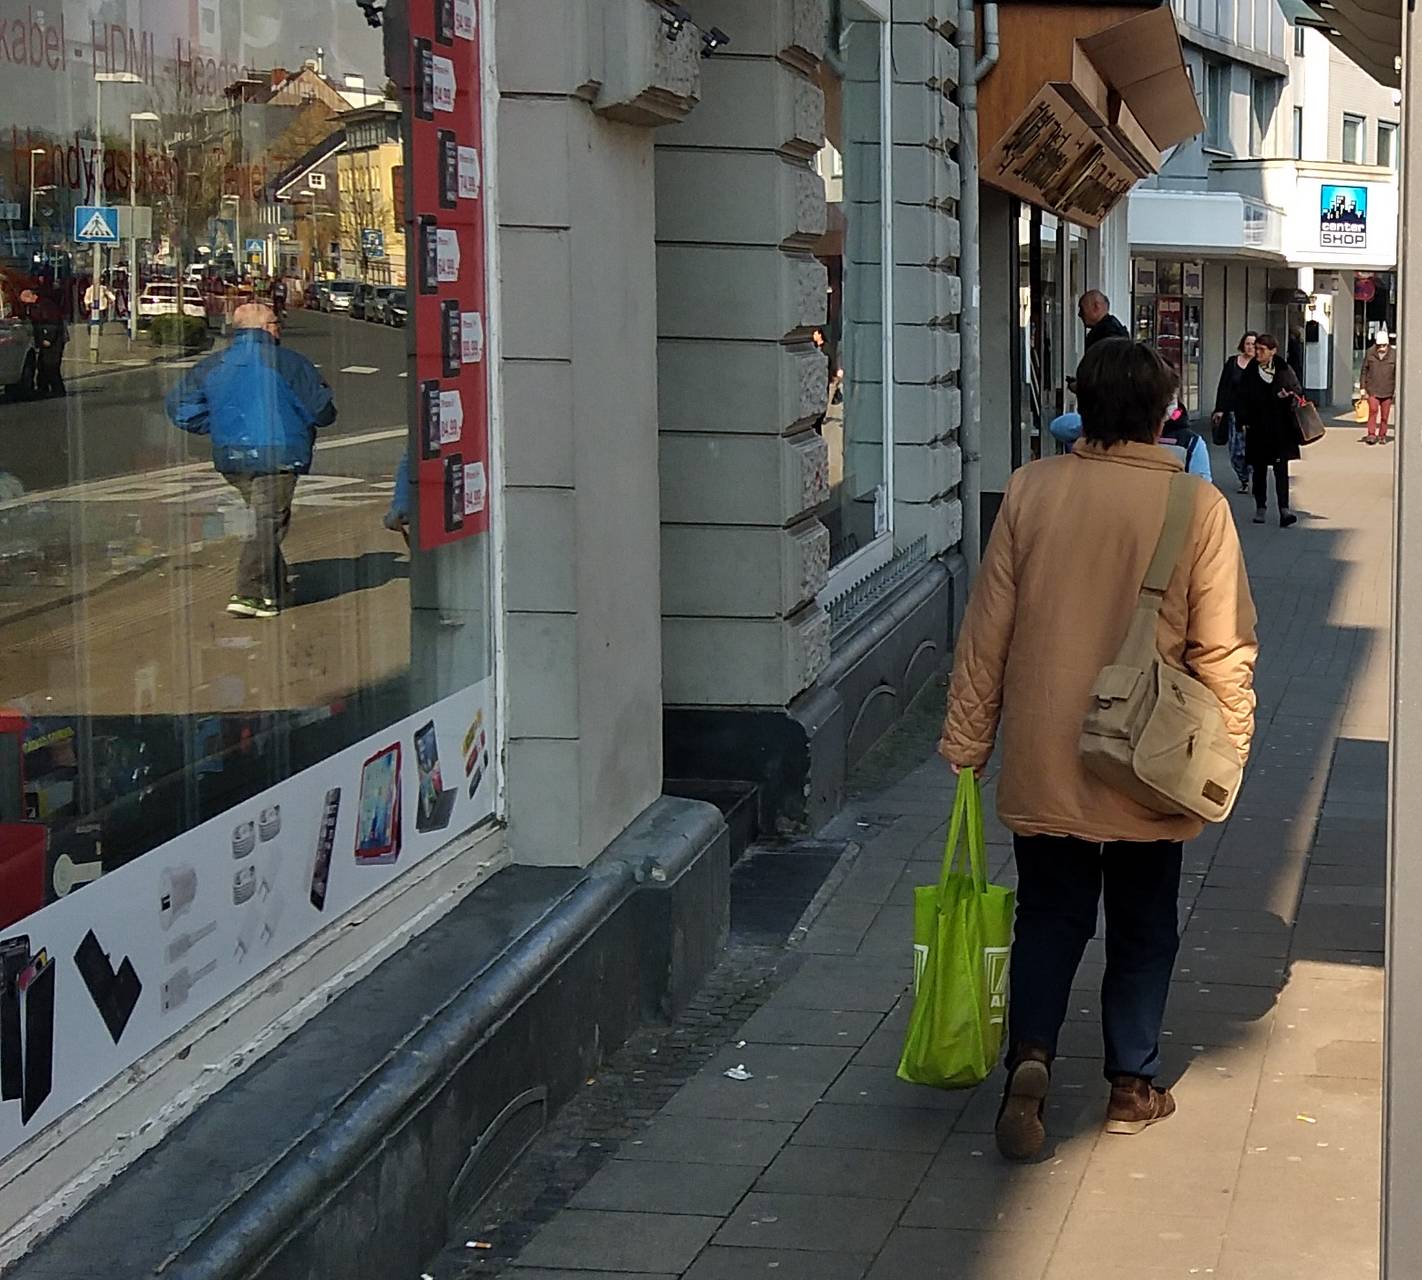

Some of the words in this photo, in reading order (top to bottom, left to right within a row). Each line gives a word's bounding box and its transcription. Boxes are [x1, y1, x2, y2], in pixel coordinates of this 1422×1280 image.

[91, 19, 155, 88] HDMI
[1321, 222, 1365, 232] center
[1322, 233, 1364, 245] SHOP
